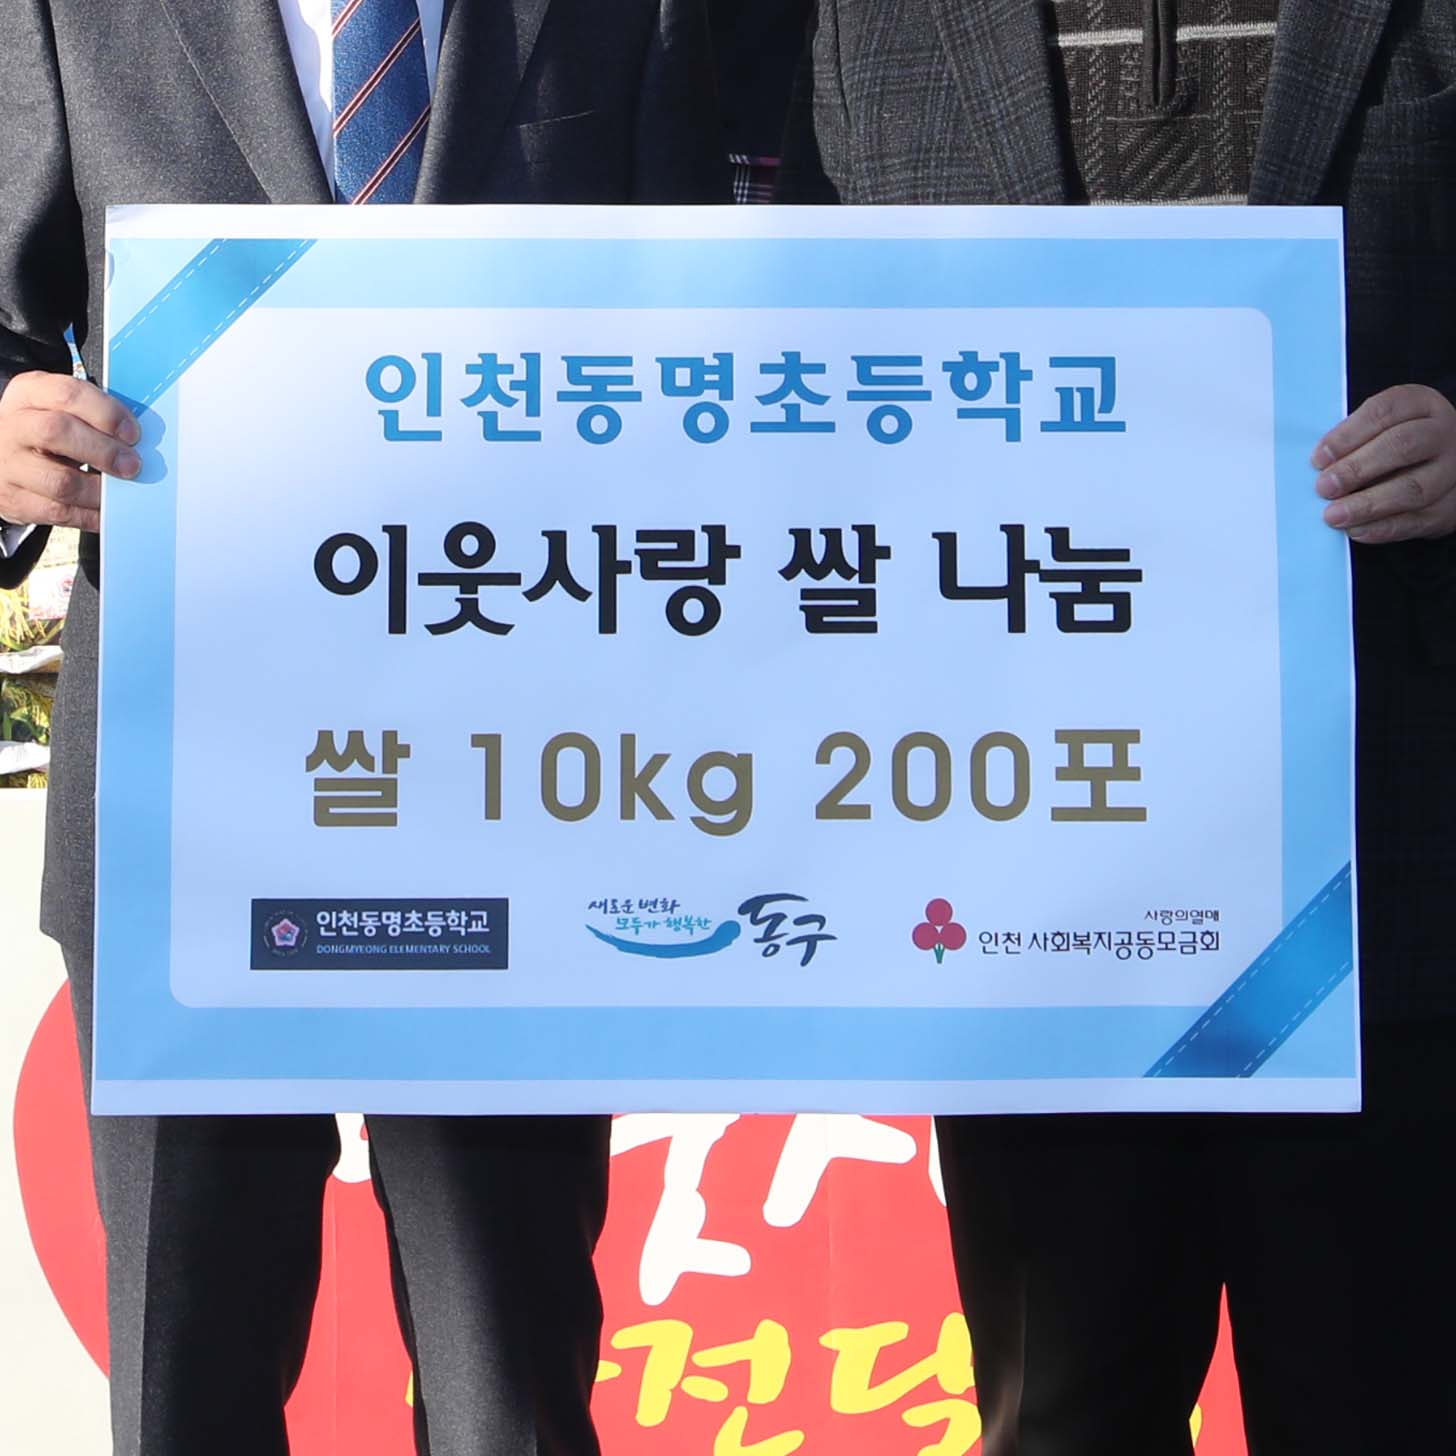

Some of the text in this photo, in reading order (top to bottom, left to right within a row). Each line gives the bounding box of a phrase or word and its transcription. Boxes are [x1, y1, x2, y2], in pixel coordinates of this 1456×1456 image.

[365, 350, 1127, 445] 인천동명초등학교
[313, 521, 1143, 637] 이웃사랑 쌀 나눔
[305, 728, 1147, 837] 쌀 10kg 200포
[588, 897, 681, 915] 새로운 변화
[1144, 909, 1220, 926] 사랑의열매
[316, 909, 490, 937] 인천동명초등학교
[616, 916, 712, 935] 모두가 행복한
[737, 892, 838, 968] 동구
[316, 944, 491, 954] DONGMYEONG ELEMENTARY SCHOOL
[978, 929, 1220, 961] 인천 사회복지공동모금회
